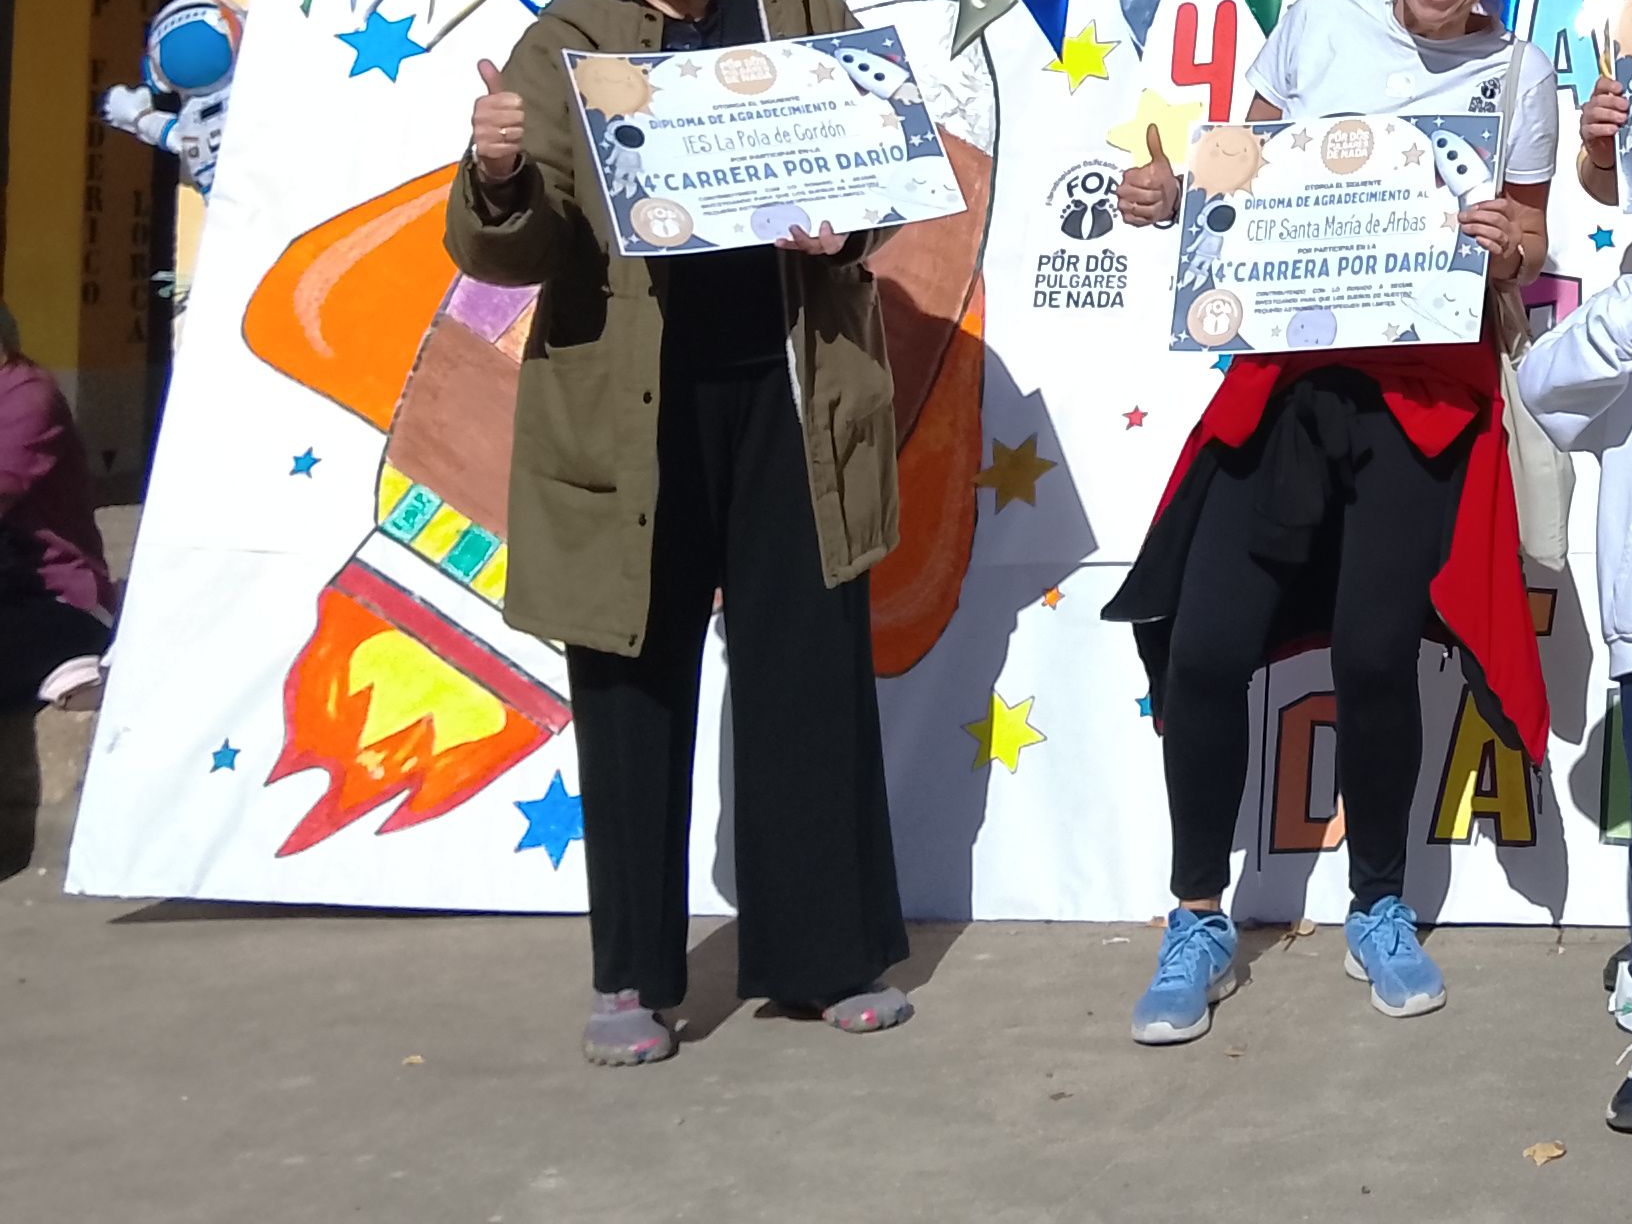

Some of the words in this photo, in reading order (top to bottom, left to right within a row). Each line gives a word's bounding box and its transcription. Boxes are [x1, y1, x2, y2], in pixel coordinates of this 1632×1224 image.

[1171, 0, 1238, 123] 4
[649, 116, 706, 130] DIPLOMA
[707, 114, 725, 125] DE
[729, 100, 837, 122] AGRADECIMIENTO
[682, 134, 712, 154] IES
[714, 133, 736, 151] La
[736, 128, 771, 148] Pola
[774, 125, 792, 143] de
[783, 156, 831, 177] POR
[835, 142, 904, 170] DARÍO
[1066, 172, 1119, 199] FOP
[1244, 197, 1293, 210] DIPLOMA
[1296, 196, 1311, 207] DE
[1313, 189, 1411, 206] AGRADECIMIENTO
[1247, 219, 1276, 241] CEIP
[1279, 218, 1320, 240] Santa
[1324, 214, 1361, 237] María
[1365, 213, 1380, 234] de
[1382, 210, 1426, 233] Arbas
[1037, 254, 1081, 273] POR
[1085, 254, 1128, 273] DOS
[1337, 255, 1378, 277] POR
[1384, 244, 1449, 273] DARÍO
[1035, 274, 1128, 289] PULGARES
[1033, 290, 1061, 308] DE
[1066, 290, 1124, 308] NADA
